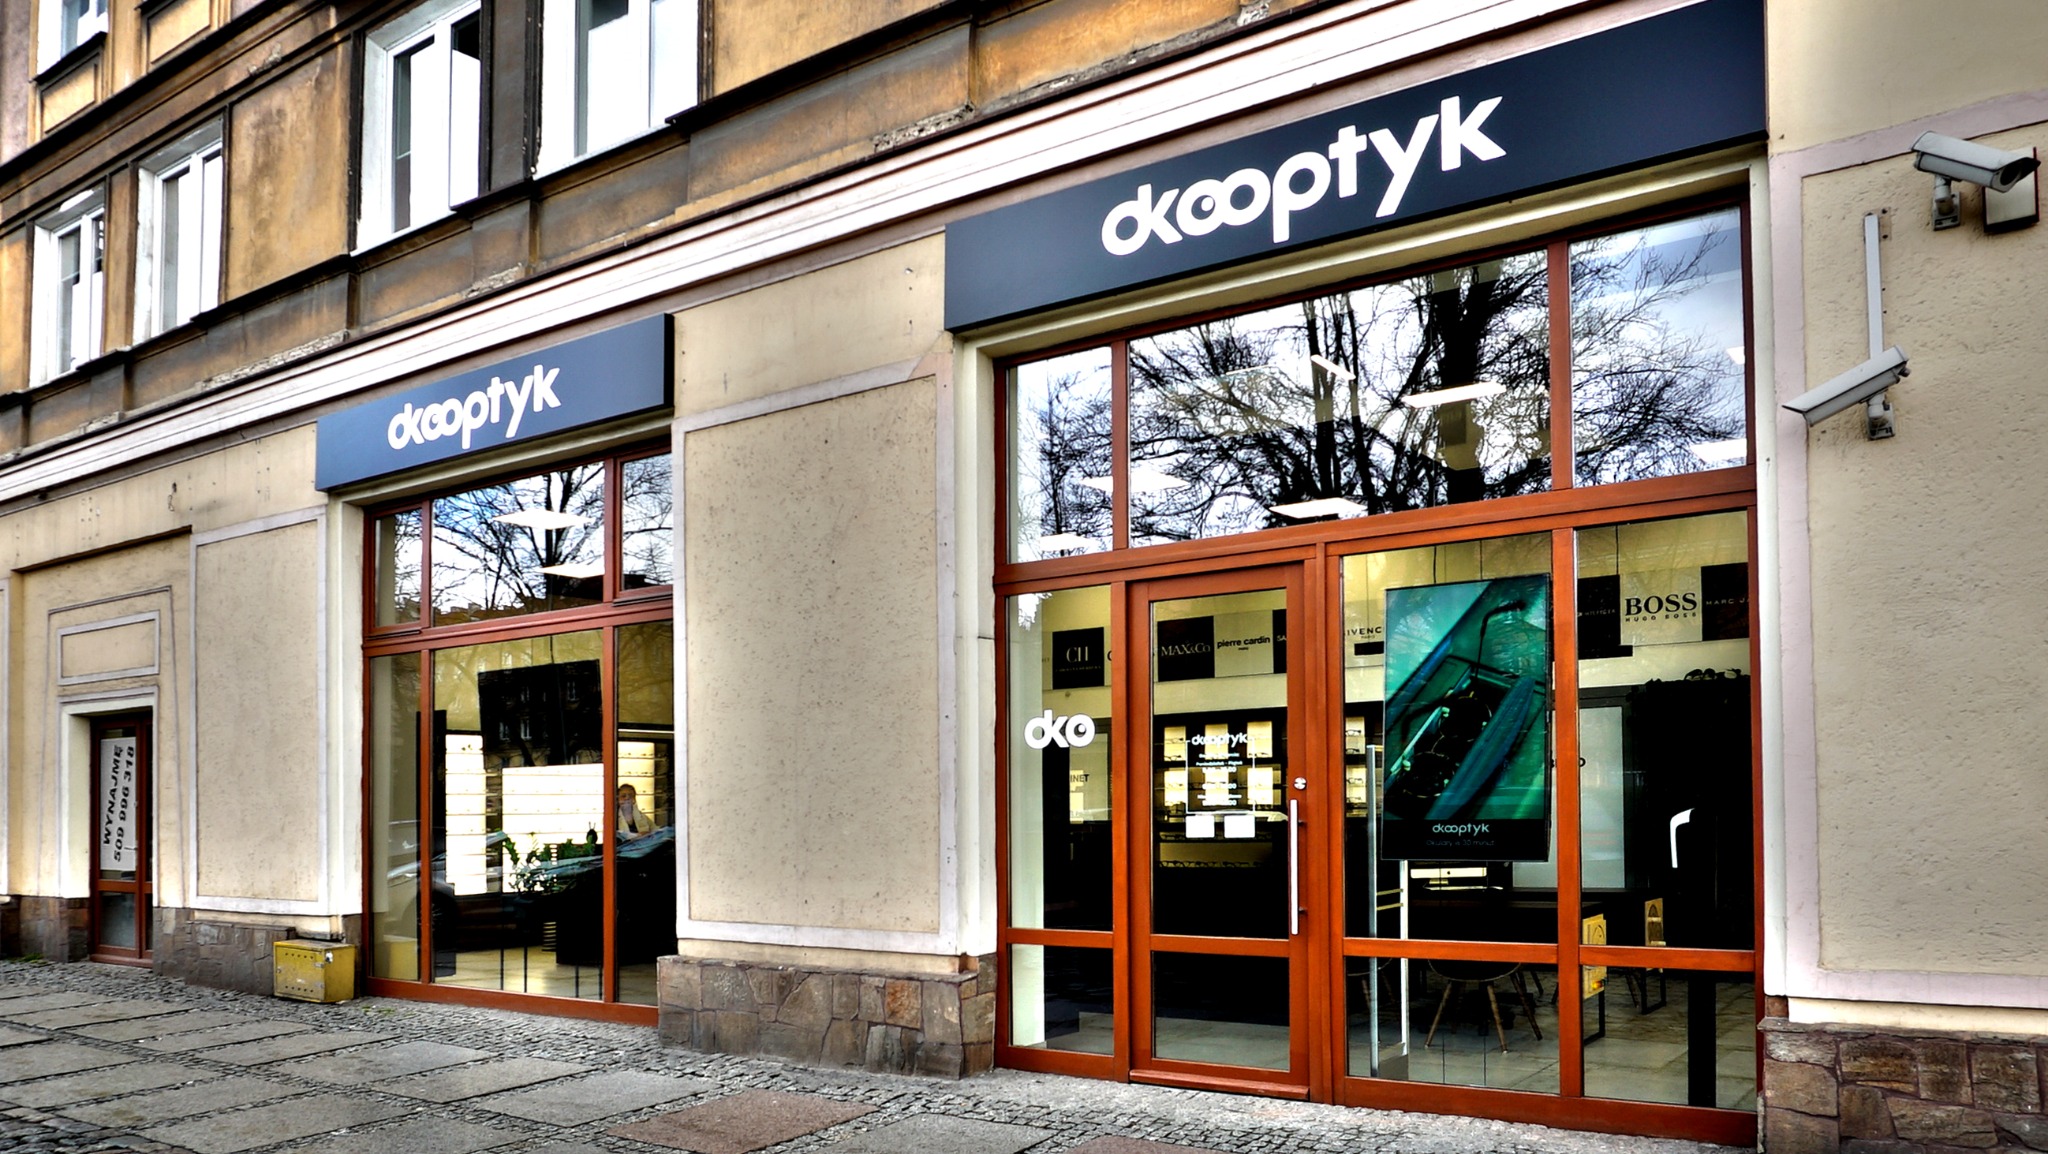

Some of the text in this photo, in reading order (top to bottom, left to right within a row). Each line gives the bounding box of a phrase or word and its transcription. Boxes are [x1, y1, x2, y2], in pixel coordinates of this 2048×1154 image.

[1625, 592, 1697, 616] BOSS
[1706, 598, 1734, 606] MARC
[1344, 626, 1382, 636] IVENC
[1216, 639, 1241, 649] pierre
[1244, 635, 1270, 645] cardin
